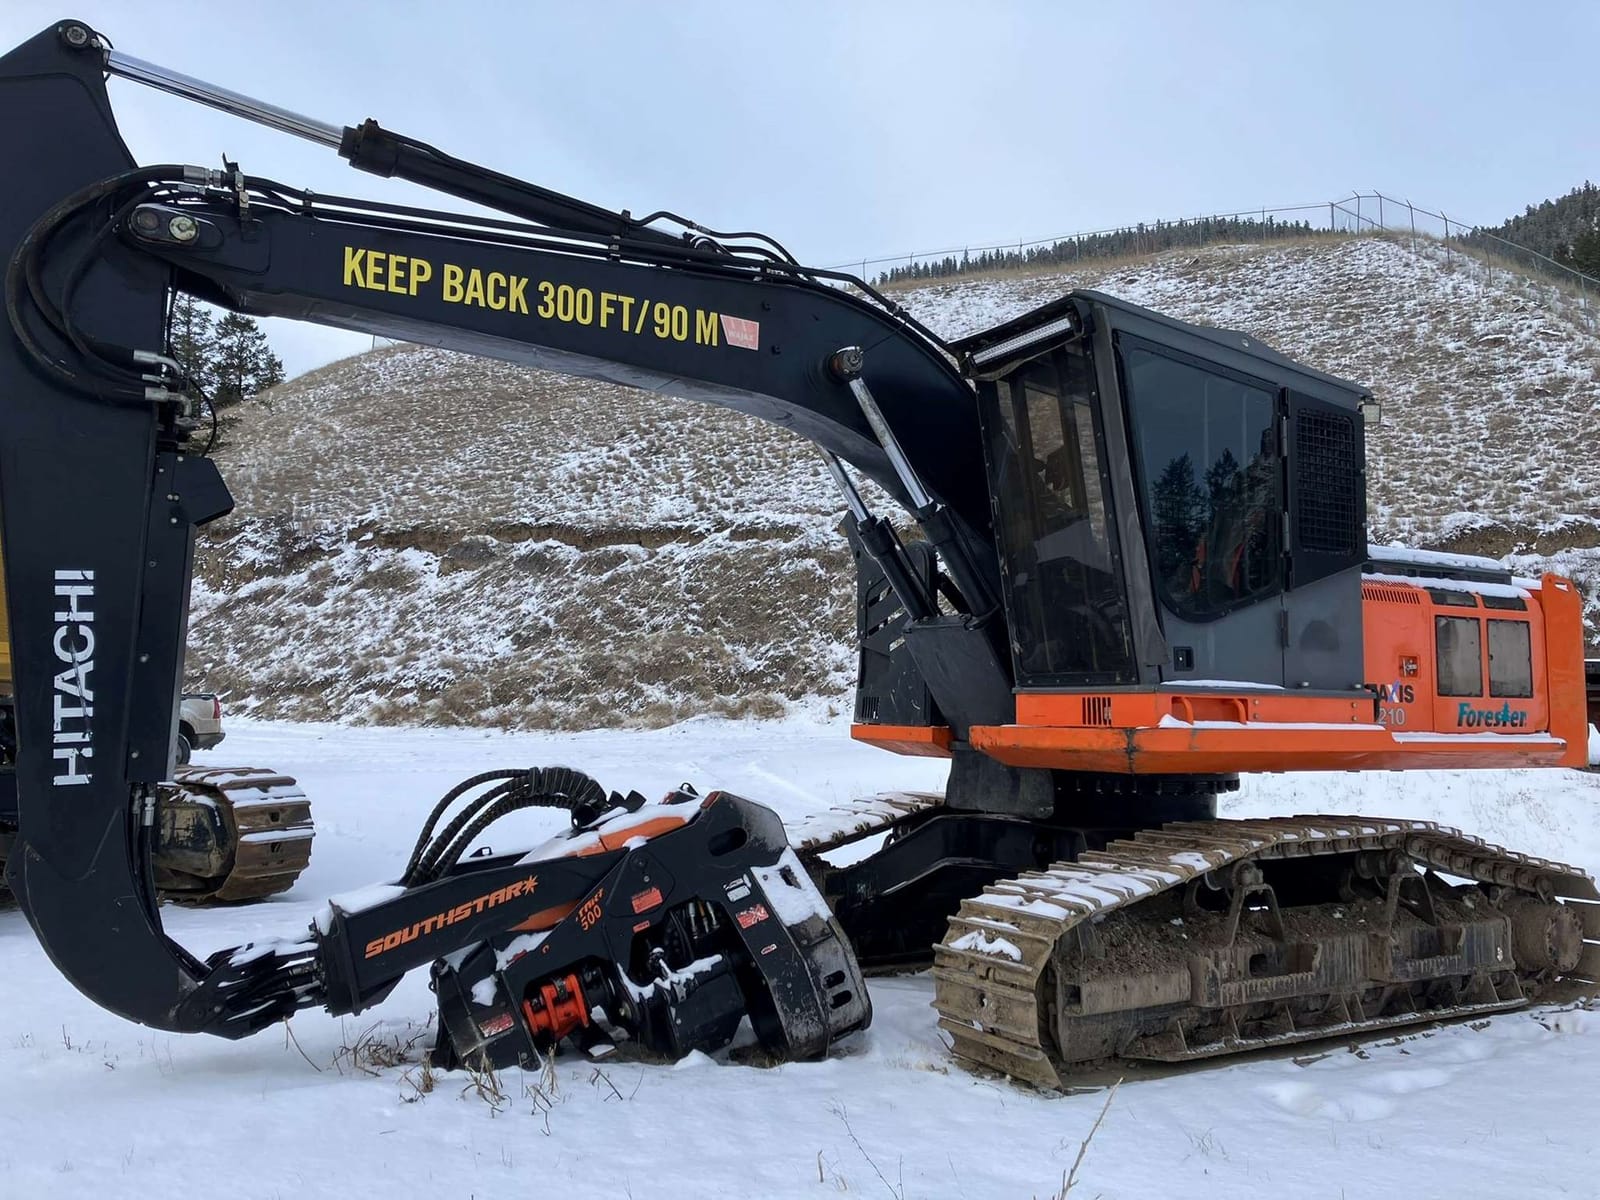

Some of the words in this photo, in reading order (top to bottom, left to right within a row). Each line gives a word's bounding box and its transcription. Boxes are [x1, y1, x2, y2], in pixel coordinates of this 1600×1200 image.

[343, 246, 432, 296] KEEP
[442, 263, 529, 315] BACK
[537, 280, 594, 326] 300
[695, 309, 718, 347] M
[53, 569, 95, 786] HITACHI
[1378, 707, 1406, 726] 210
[1457, 701, 1527, 728] Forester
[364, 879, 523, 960] SOUTHSTAR
[580, 904, 601, 931] 500
